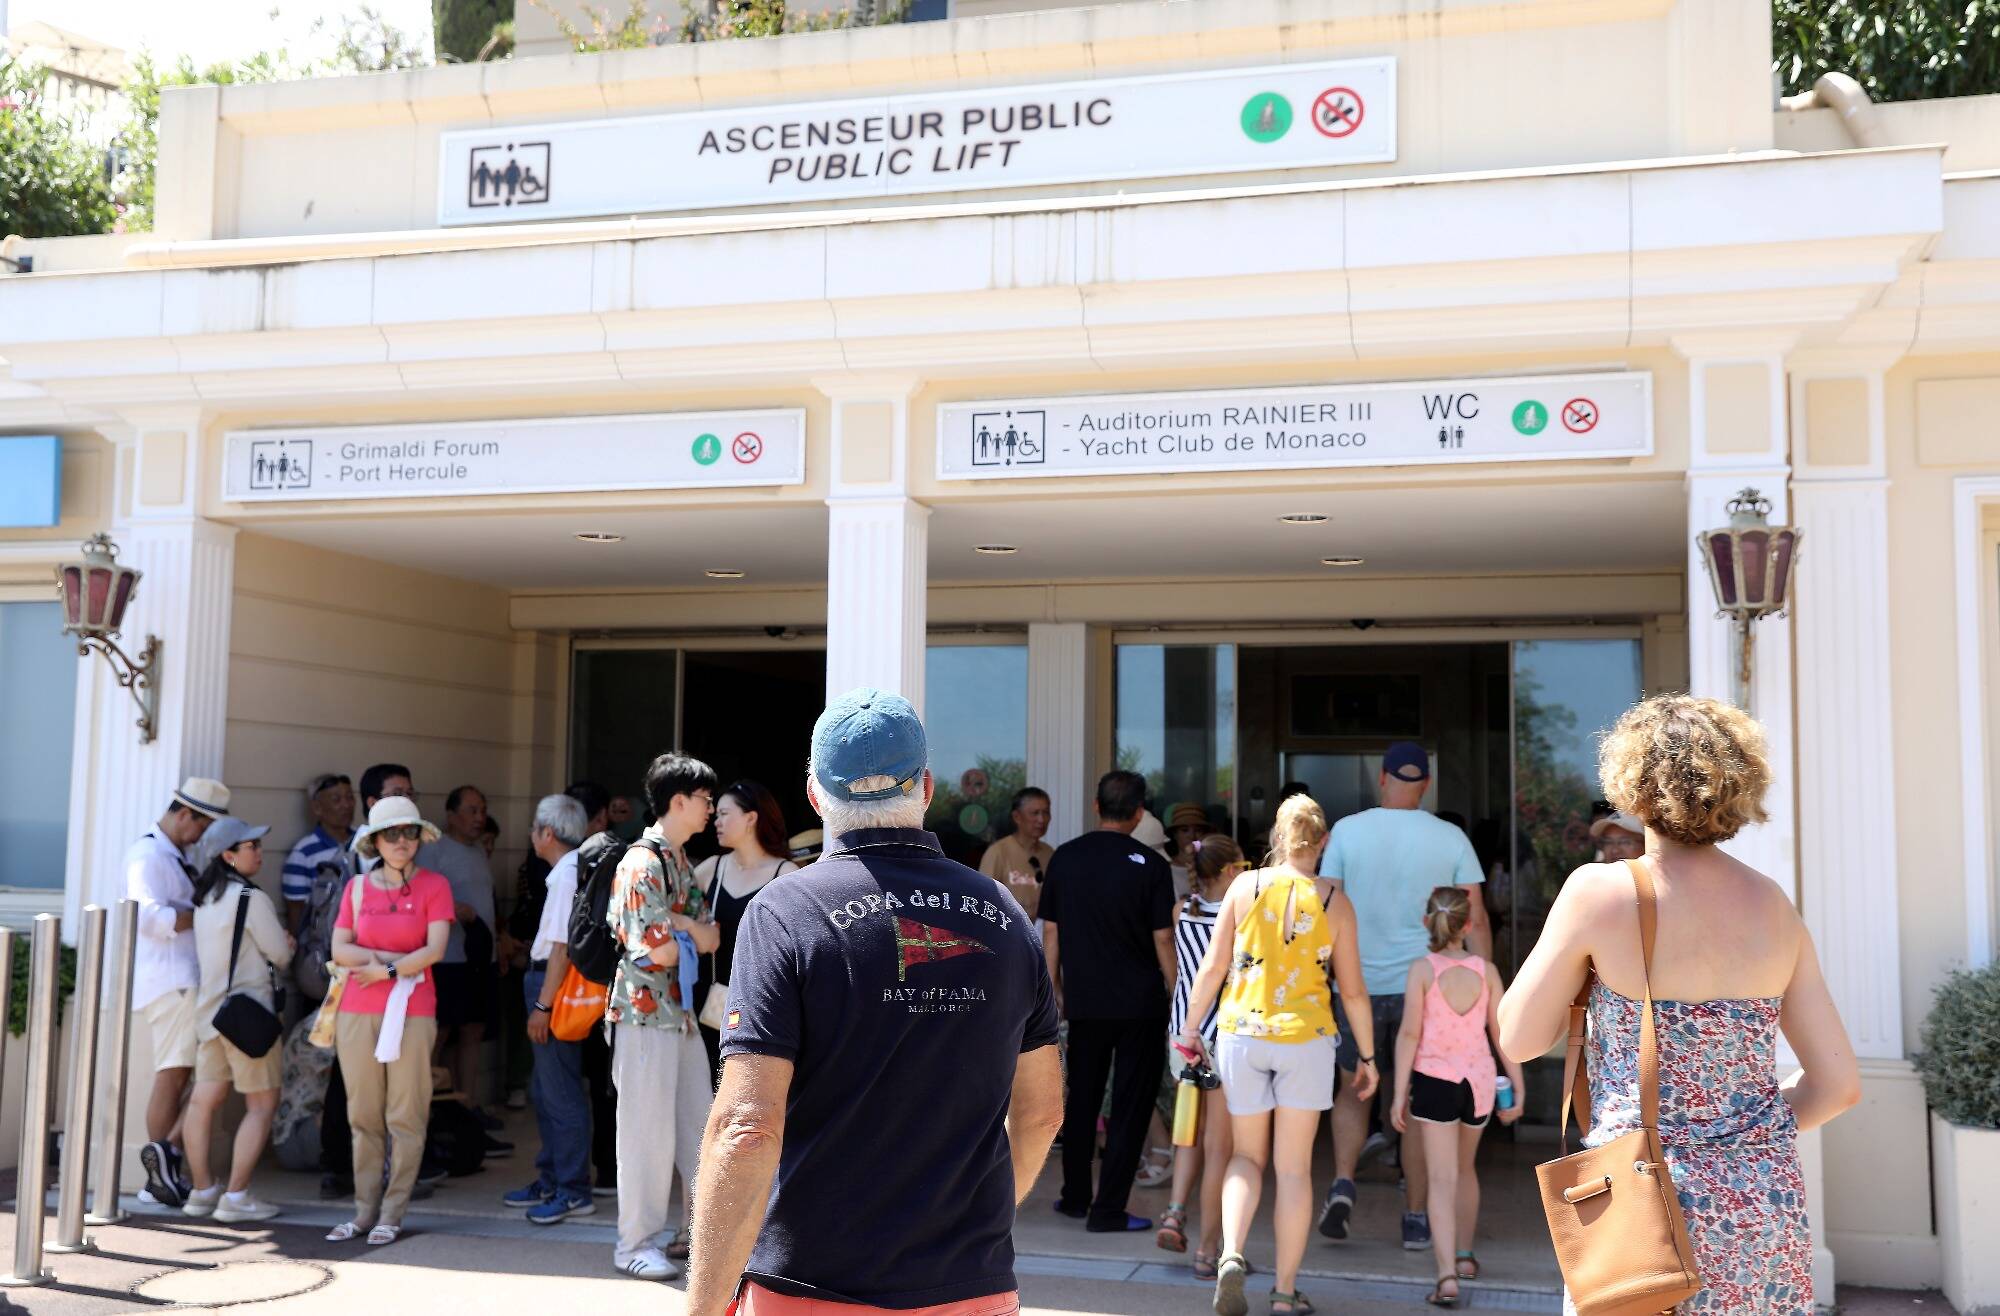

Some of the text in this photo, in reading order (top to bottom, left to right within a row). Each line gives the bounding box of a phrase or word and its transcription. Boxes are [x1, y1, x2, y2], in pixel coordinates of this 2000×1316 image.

[697, 97, 1113, 156] ASCENSEUR PUBLIC
[768, 139, 1022, 185] PUBLIC LIFT
[1077, 411, 1212, 433] Auditorium
[1223, 402, 1337, 427] RAINIER
[1349, 401, 1372, 422] III
[1421, 393, 1480, 420] WC
[340, 440, 425, 460] Grimaldi
[433, 439, 500, 457] Forum
[1079, 436, 1149, 457] Yacht
[1157, 433, 1214, 454] Club
[1224, 432, 1255, 452] de
[1265, 430, 1367, 450] Monaco
[339, 464, 381, 482] Port
[388, 462, 468, 481] Hercule
[829, 889, 1013, 931] COPA del REY
[882, 988, 917, 1002] BAY
[921, 987, 936, 1000] of
